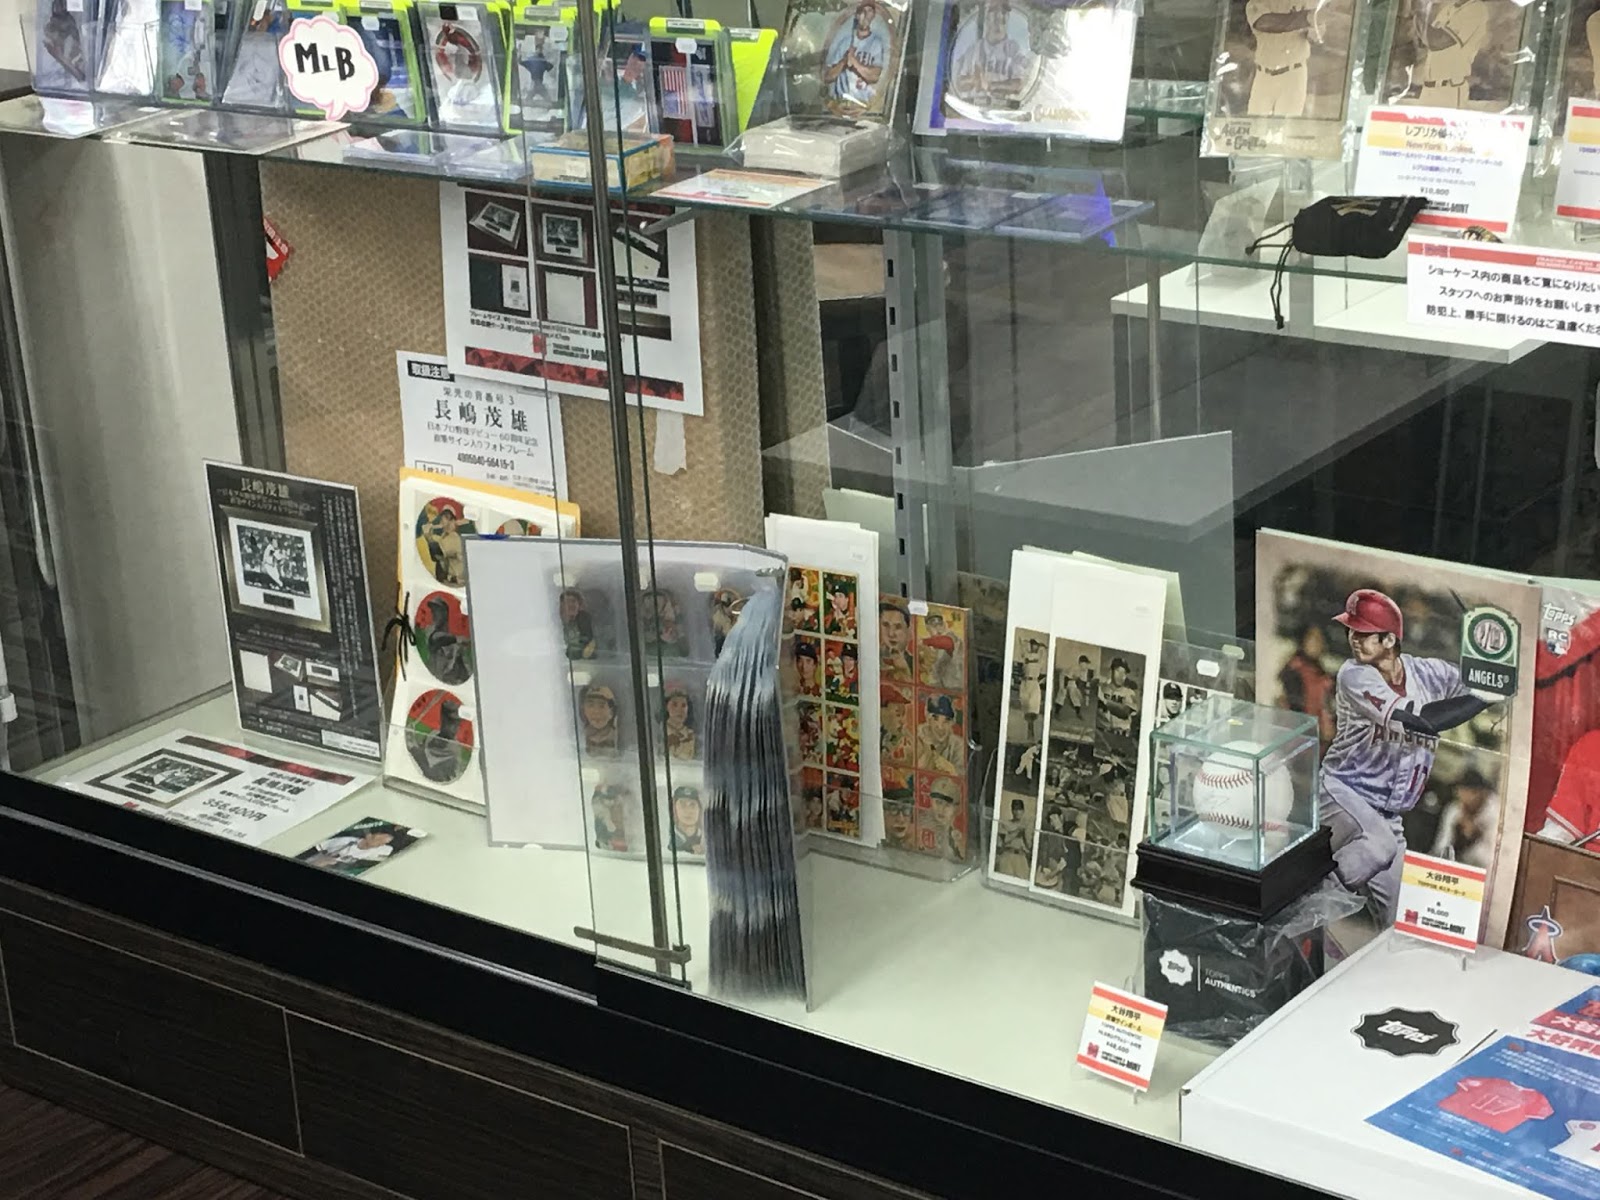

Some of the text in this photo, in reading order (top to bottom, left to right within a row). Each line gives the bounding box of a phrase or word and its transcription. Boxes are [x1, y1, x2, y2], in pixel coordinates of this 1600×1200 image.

[294, 42, 356, 81] MLB
[435, 399, 528, 432] 長嶋茂雄
[1468, 668, 1504, 689] ANGELS
[1204, 976, 1257, 999] AUTHENTICS
